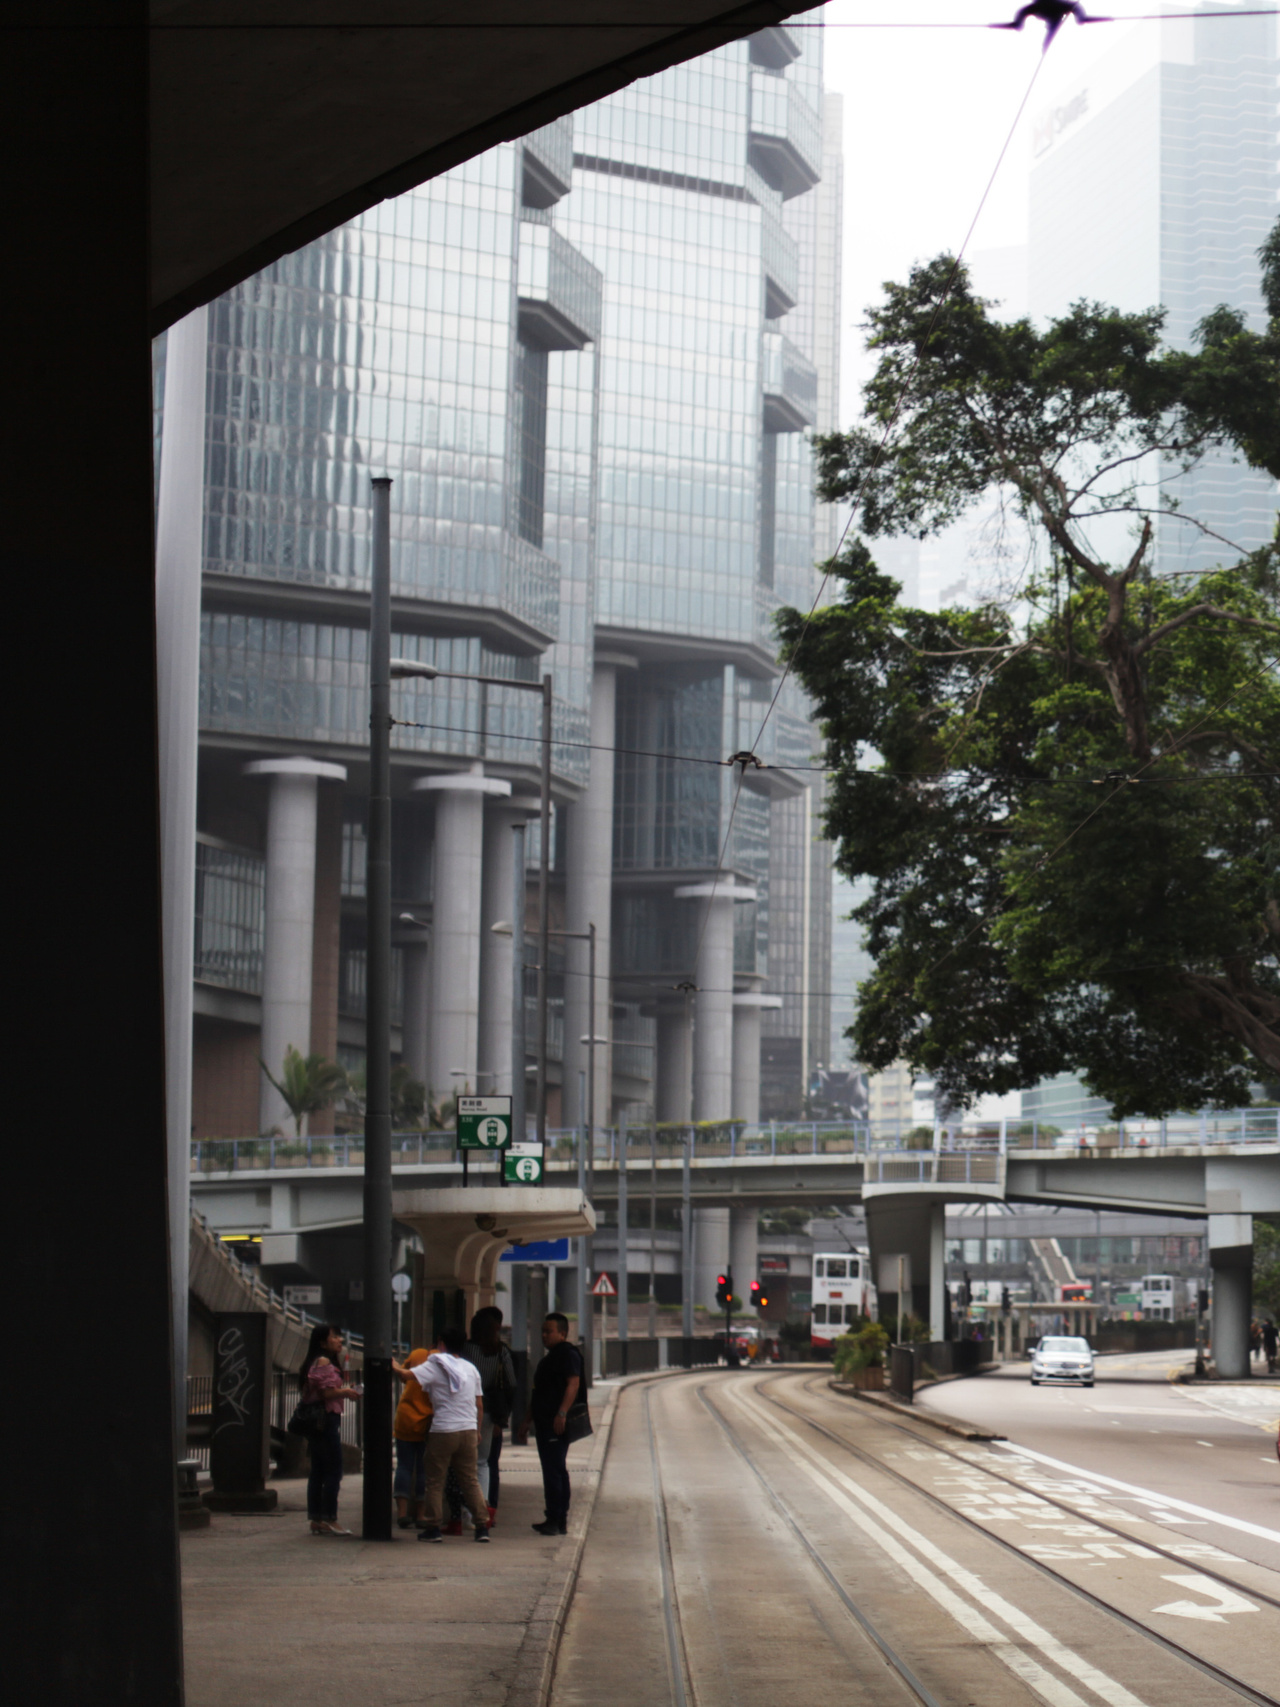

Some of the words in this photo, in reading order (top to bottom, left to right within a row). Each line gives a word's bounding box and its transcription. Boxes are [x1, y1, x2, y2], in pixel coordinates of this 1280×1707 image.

[939, 1493, 1170, 1510] LANE
[958, 1508, 1209, 1524] TRAM
[1019, 1543, 1248, 1562] BUS
